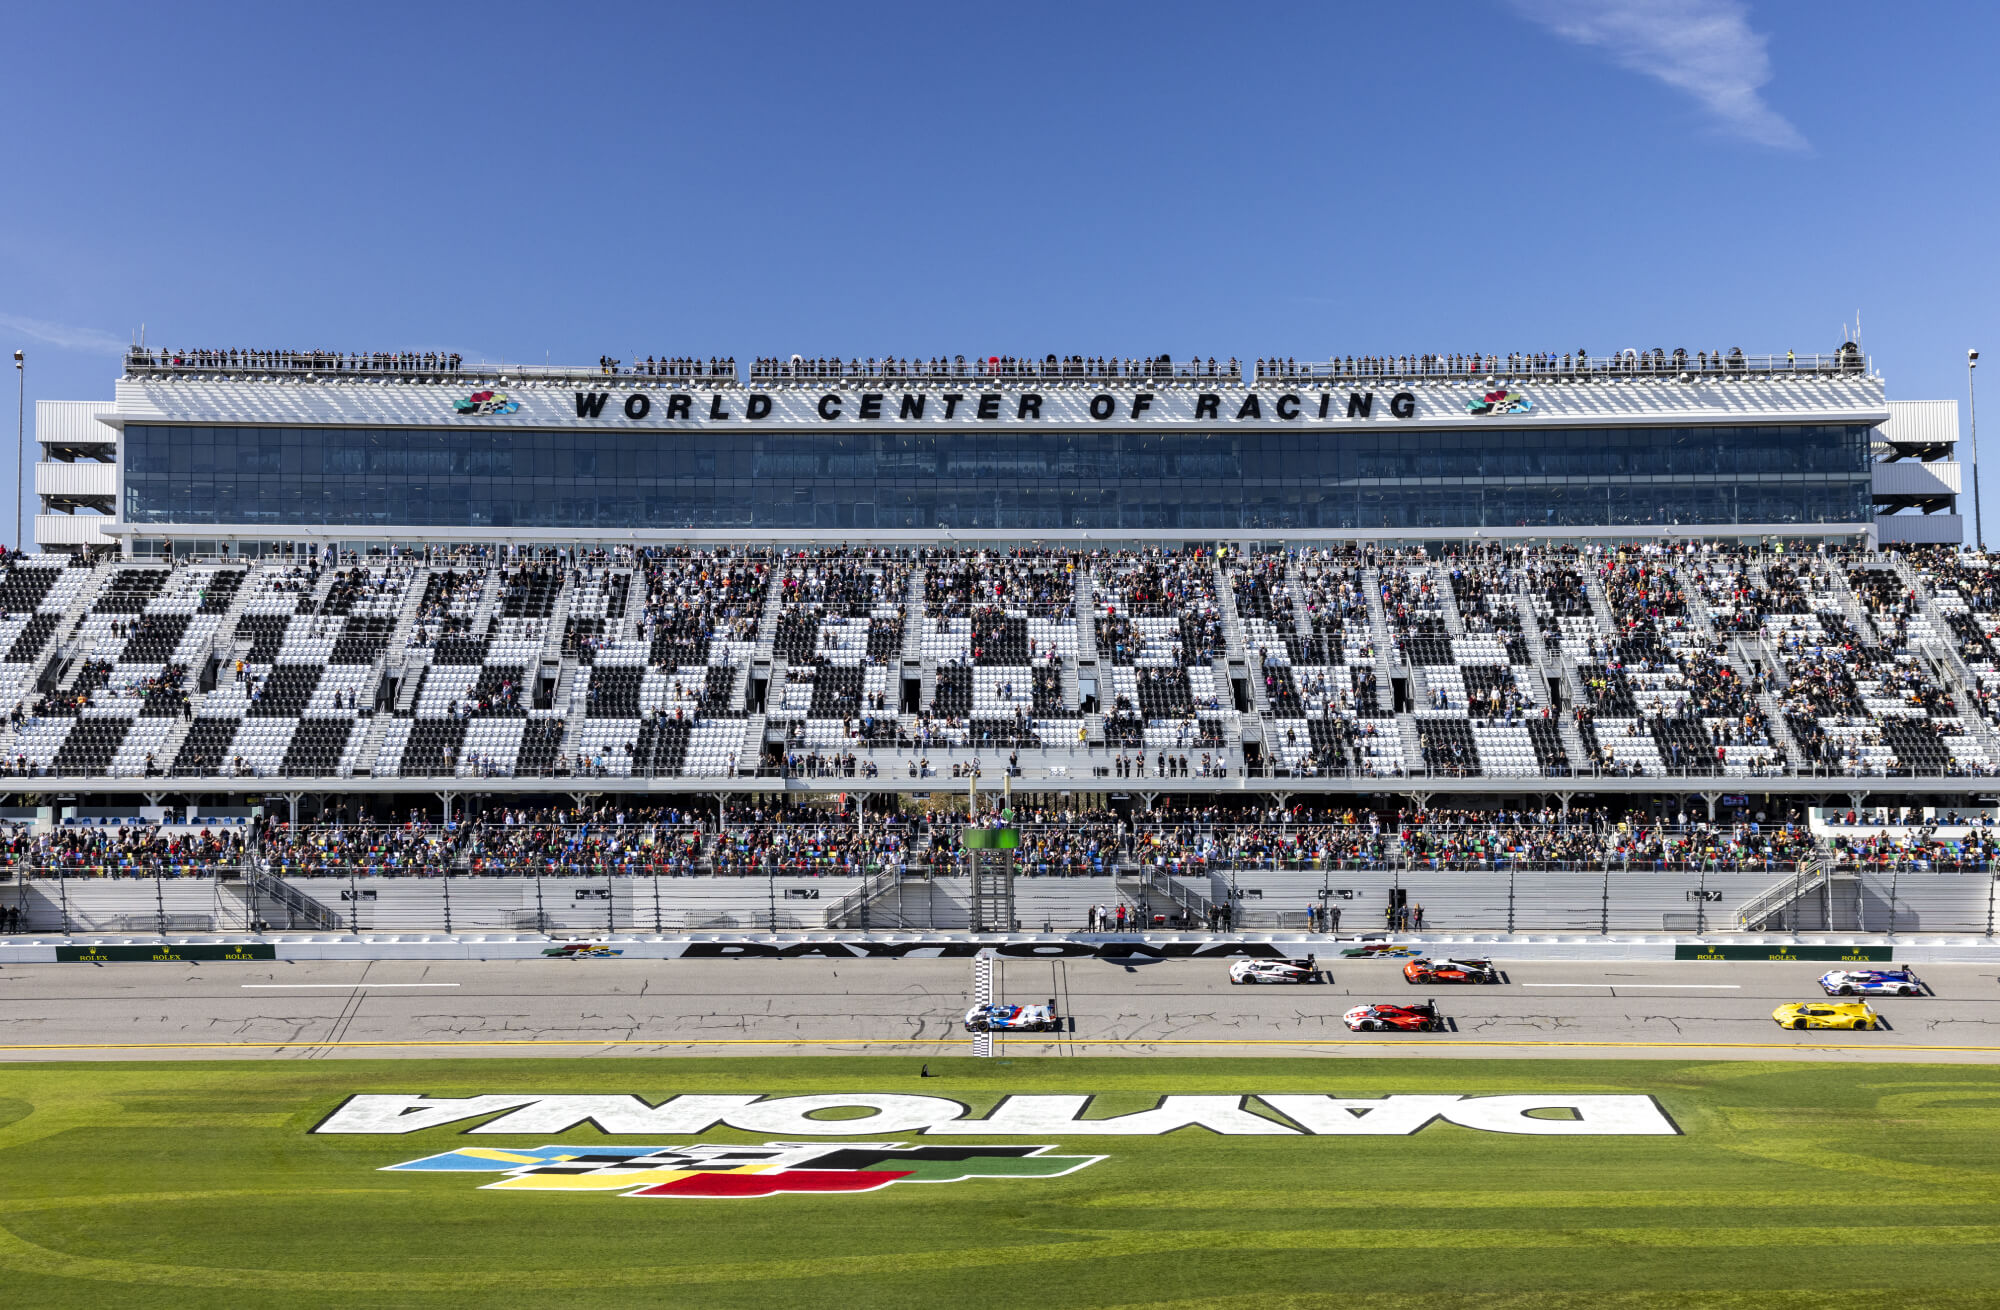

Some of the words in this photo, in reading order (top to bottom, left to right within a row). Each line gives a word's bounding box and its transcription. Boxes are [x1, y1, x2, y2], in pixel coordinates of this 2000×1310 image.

[575, 392, 772, 420] WORLD
[818, 393, 1043, 420] CENTER
[1090, 393, 1154, 420] OF
[1195, 392, 1415, 420] RACING
[680, 942, 1287, 958] DAYTONA
[306, 1093, 1686, 1135] DAYTONA
